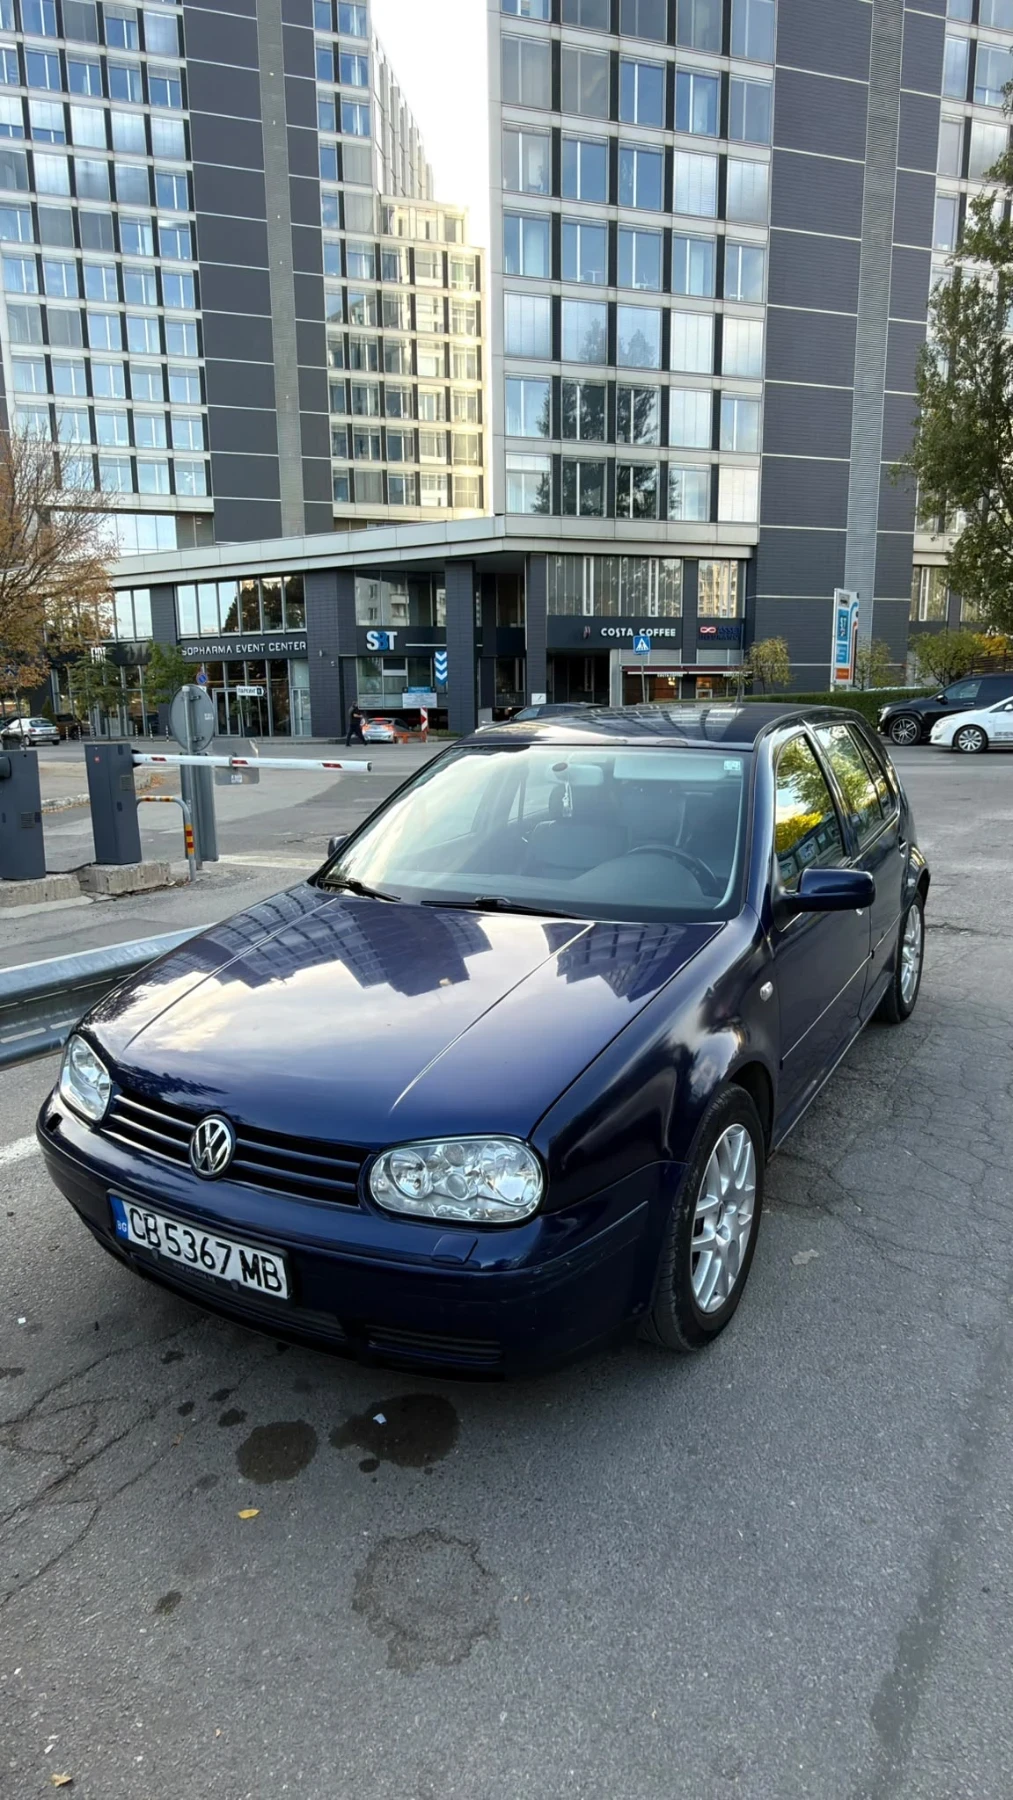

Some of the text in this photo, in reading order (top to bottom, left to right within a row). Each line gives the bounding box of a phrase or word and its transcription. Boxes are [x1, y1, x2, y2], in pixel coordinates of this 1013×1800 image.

[600, 627, 677, 638] COSTA COFFEE
[366, 630, 398, 651] SBT
[181, 641, 307, 656] SOPHARMA EVENT CENTER
[116, 1220, 128, 1233] BG
[165, 1223, 232, 1274] 5367
